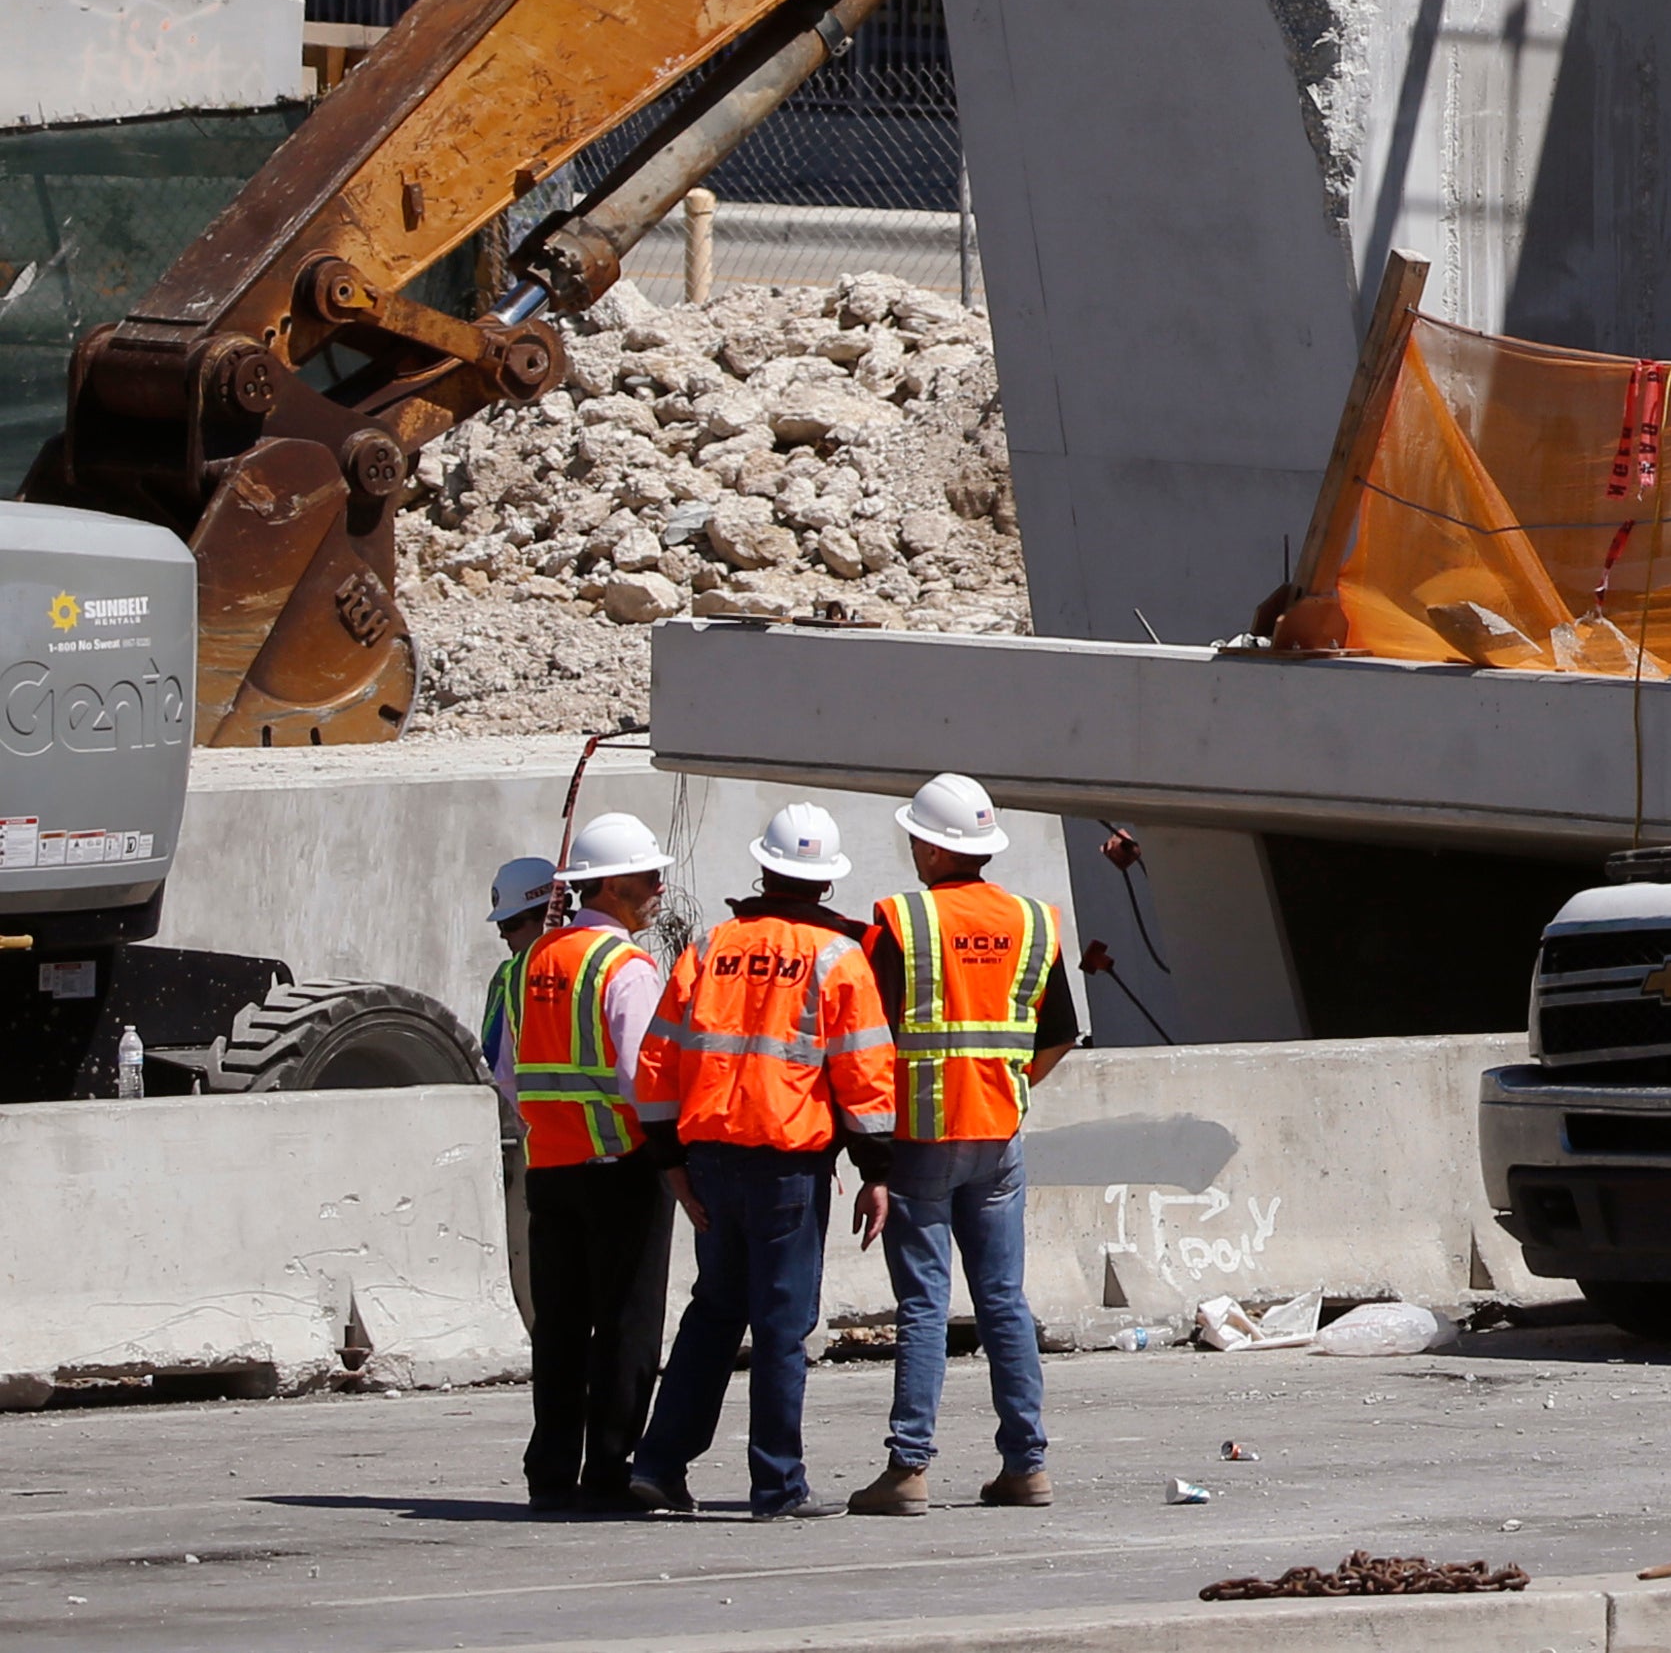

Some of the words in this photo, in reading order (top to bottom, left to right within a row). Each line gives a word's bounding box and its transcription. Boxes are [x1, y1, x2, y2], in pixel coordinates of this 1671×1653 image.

[84, 596, 149, 619] SUNBELT
[95, 617, 141, 626] RENTALS
[48, 640, 76, 653] 1-800
[78, 639, 92, 650] No
[94, 638, 120, 650] Sweat
[0, 657, 184, 757] Genie
[955, 937, 1009, 949] MCM
[715, 951, 801, 979] MCM
